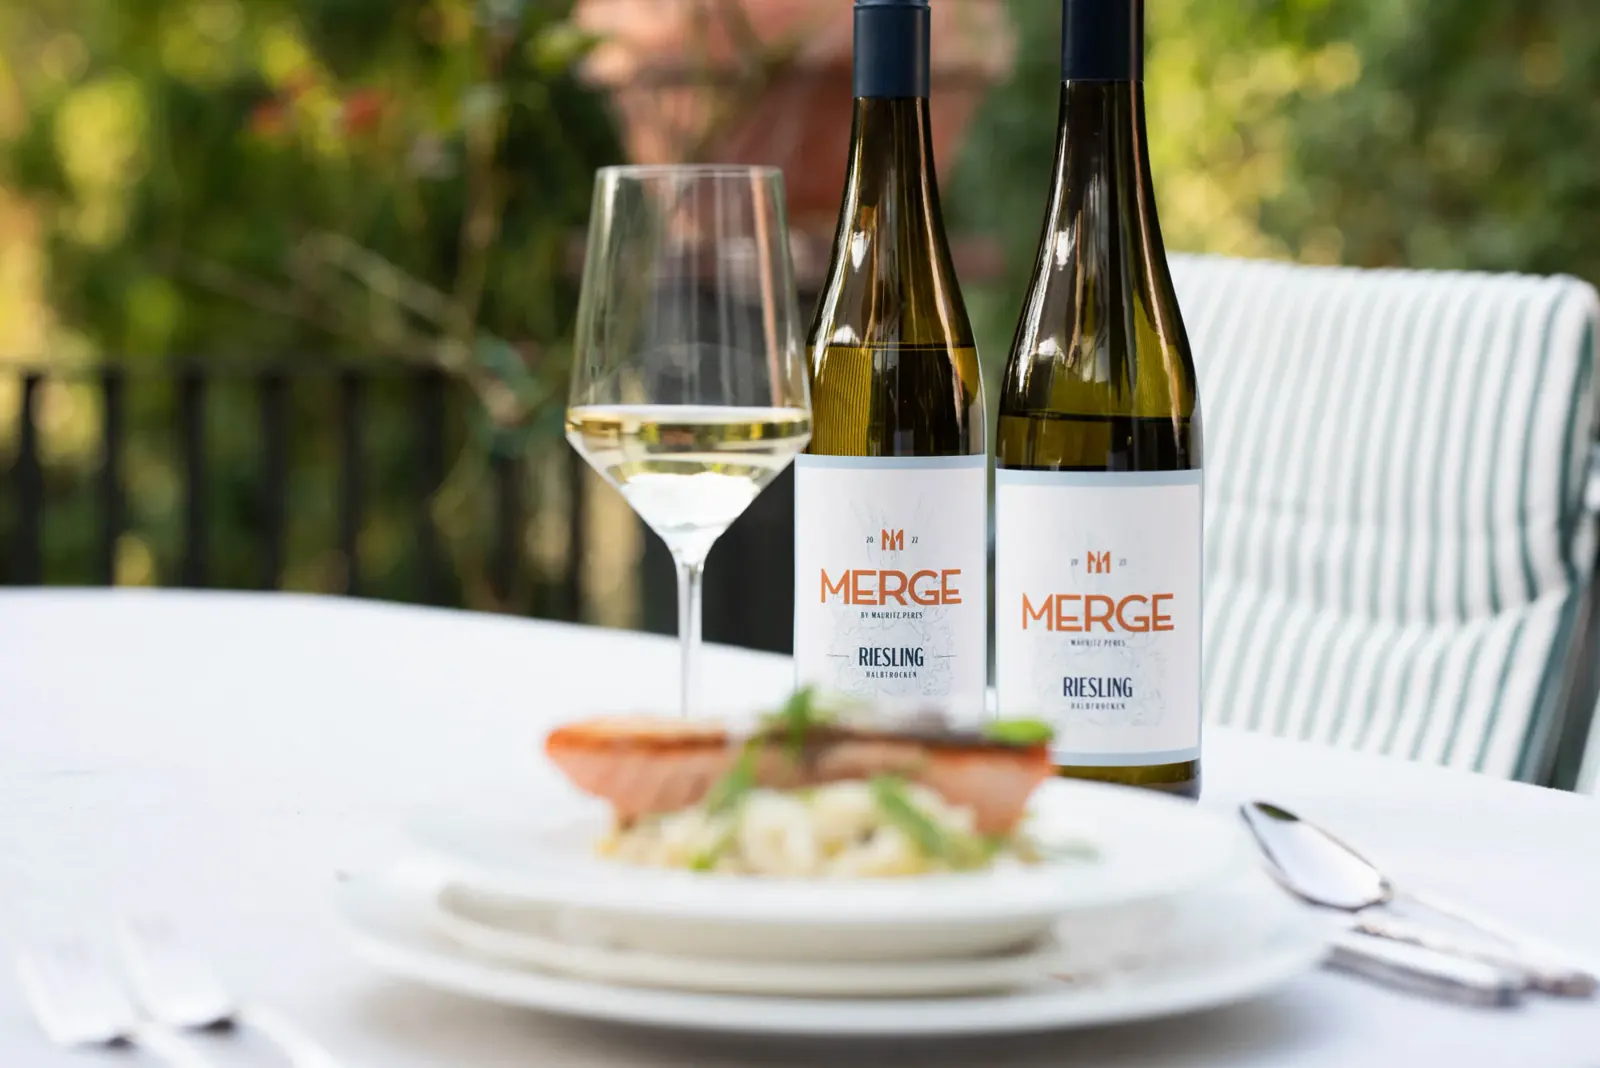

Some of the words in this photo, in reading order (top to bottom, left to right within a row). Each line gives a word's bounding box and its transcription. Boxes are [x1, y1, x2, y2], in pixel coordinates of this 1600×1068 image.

[866, 536, 874, 544] 20
[911, 536, 919, 544] 22
[820, 568, 962, 606] MERGE
[860, 611, 869, 619] BY
[871, 611, 900, 619] MAURITZ
[902, 611, 923, 619] PERES
[1022, 592, 1174, 633] MERGE
[858, 647, 924, 667] RIESLING
[866, 671, 917, 679] HALBTROCKEN
[1063, 676, 1133, 698] RIESLING
